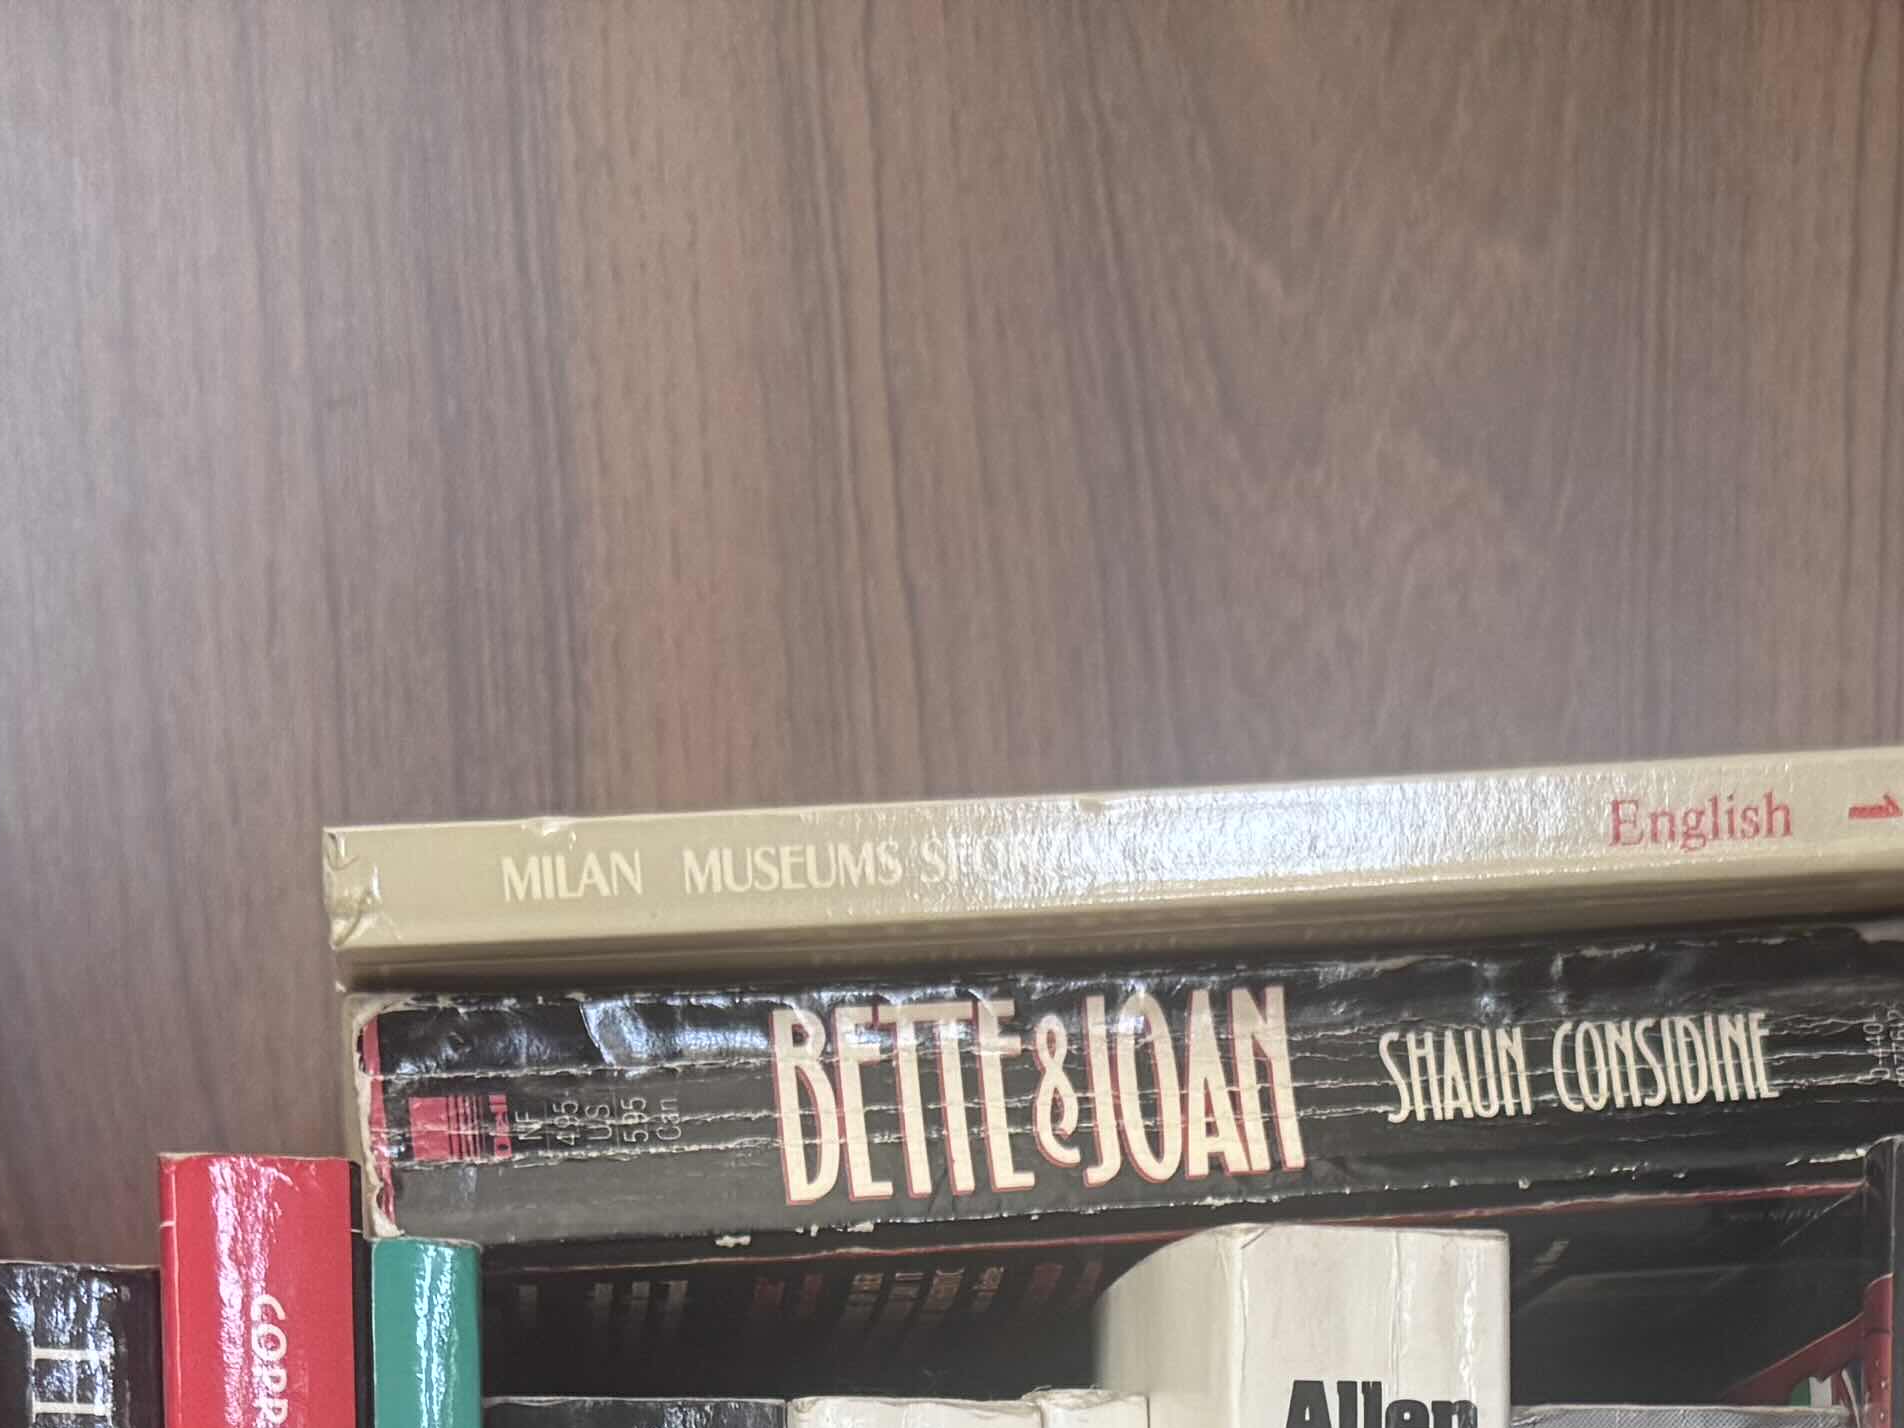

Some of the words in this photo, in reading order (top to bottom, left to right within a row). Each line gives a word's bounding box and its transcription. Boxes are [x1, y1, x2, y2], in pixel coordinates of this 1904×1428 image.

[1607, 792, 1794, 854] English
[501, 849, 644, 902] MILAN
[682, 836, 904, 895] MUSEUMS
[1377, 1029, 1534, 1124] SHAUN
[1552, 1012, 1781, 1113] CONSIDINE
